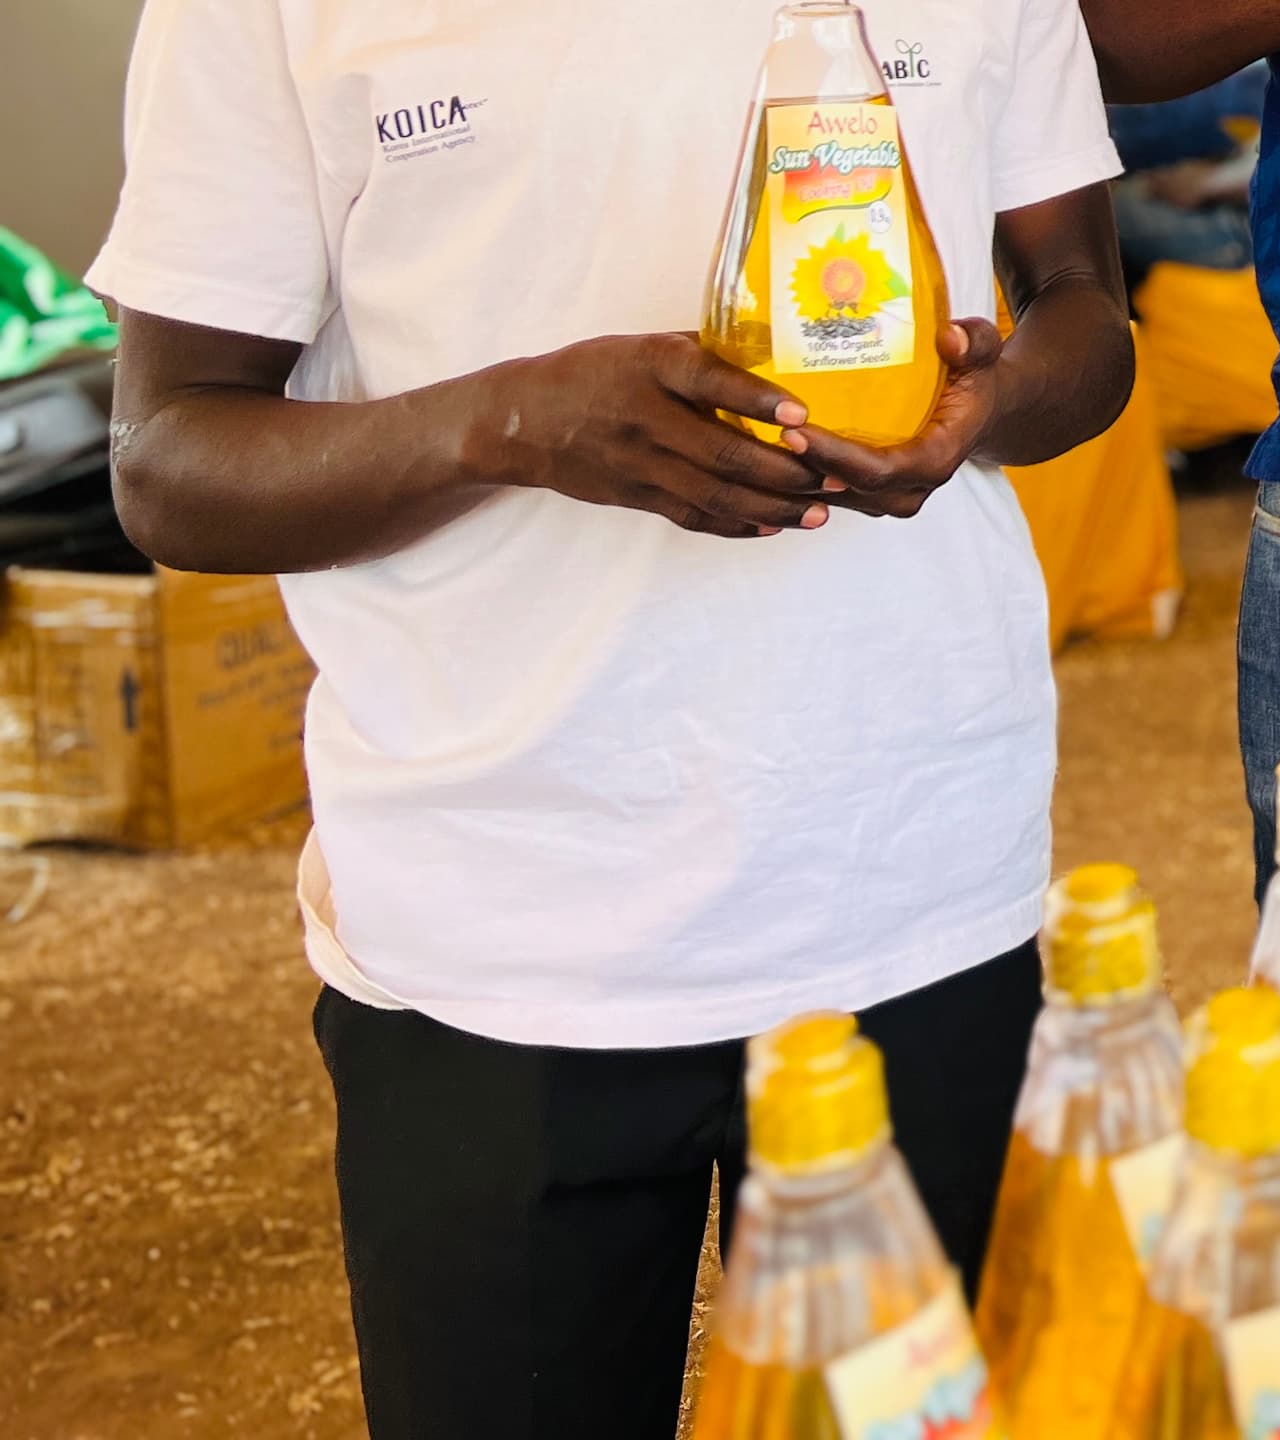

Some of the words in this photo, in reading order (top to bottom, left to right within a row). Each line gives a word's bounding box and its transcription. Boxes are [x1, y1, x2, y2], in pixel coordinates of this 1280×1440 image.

[881, 46, 931, 80] ABIC
[375, 96, 467, 144] KOICA
[807, 106, 879, 135] Awelo
[769, 145, 812, 175] Sun
[812, 139, 902, 176] Vegetable
